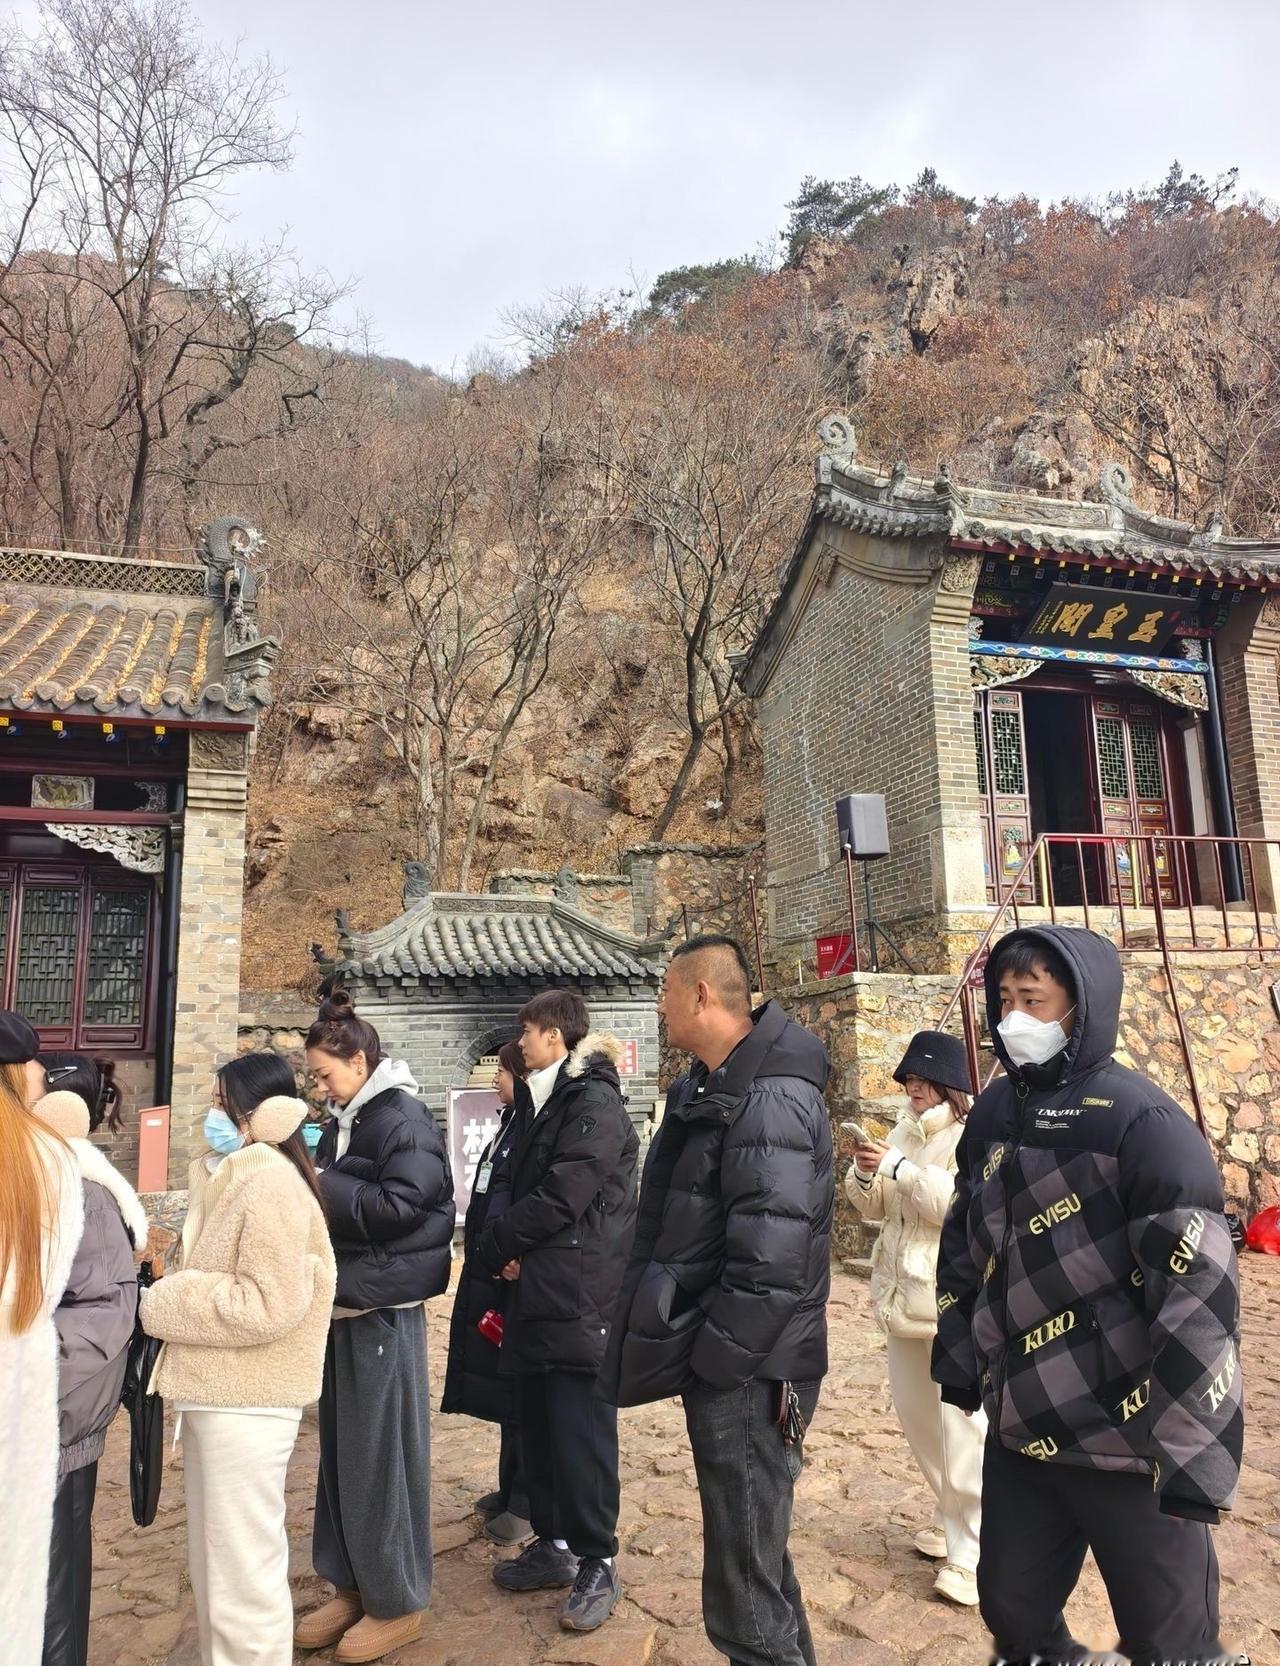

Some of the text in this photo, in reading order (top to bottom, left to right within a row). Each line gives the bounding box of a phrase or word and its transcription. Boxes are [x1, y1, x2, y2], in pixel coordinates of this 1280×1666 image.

[983, 1146, 1004, 1181] EVIS
[1029, 1193, 1081, 1235] EVISU
[1169, 1212, 1205, 1275] EVISU
[1018, 1310, 1080, 1355] KURO
